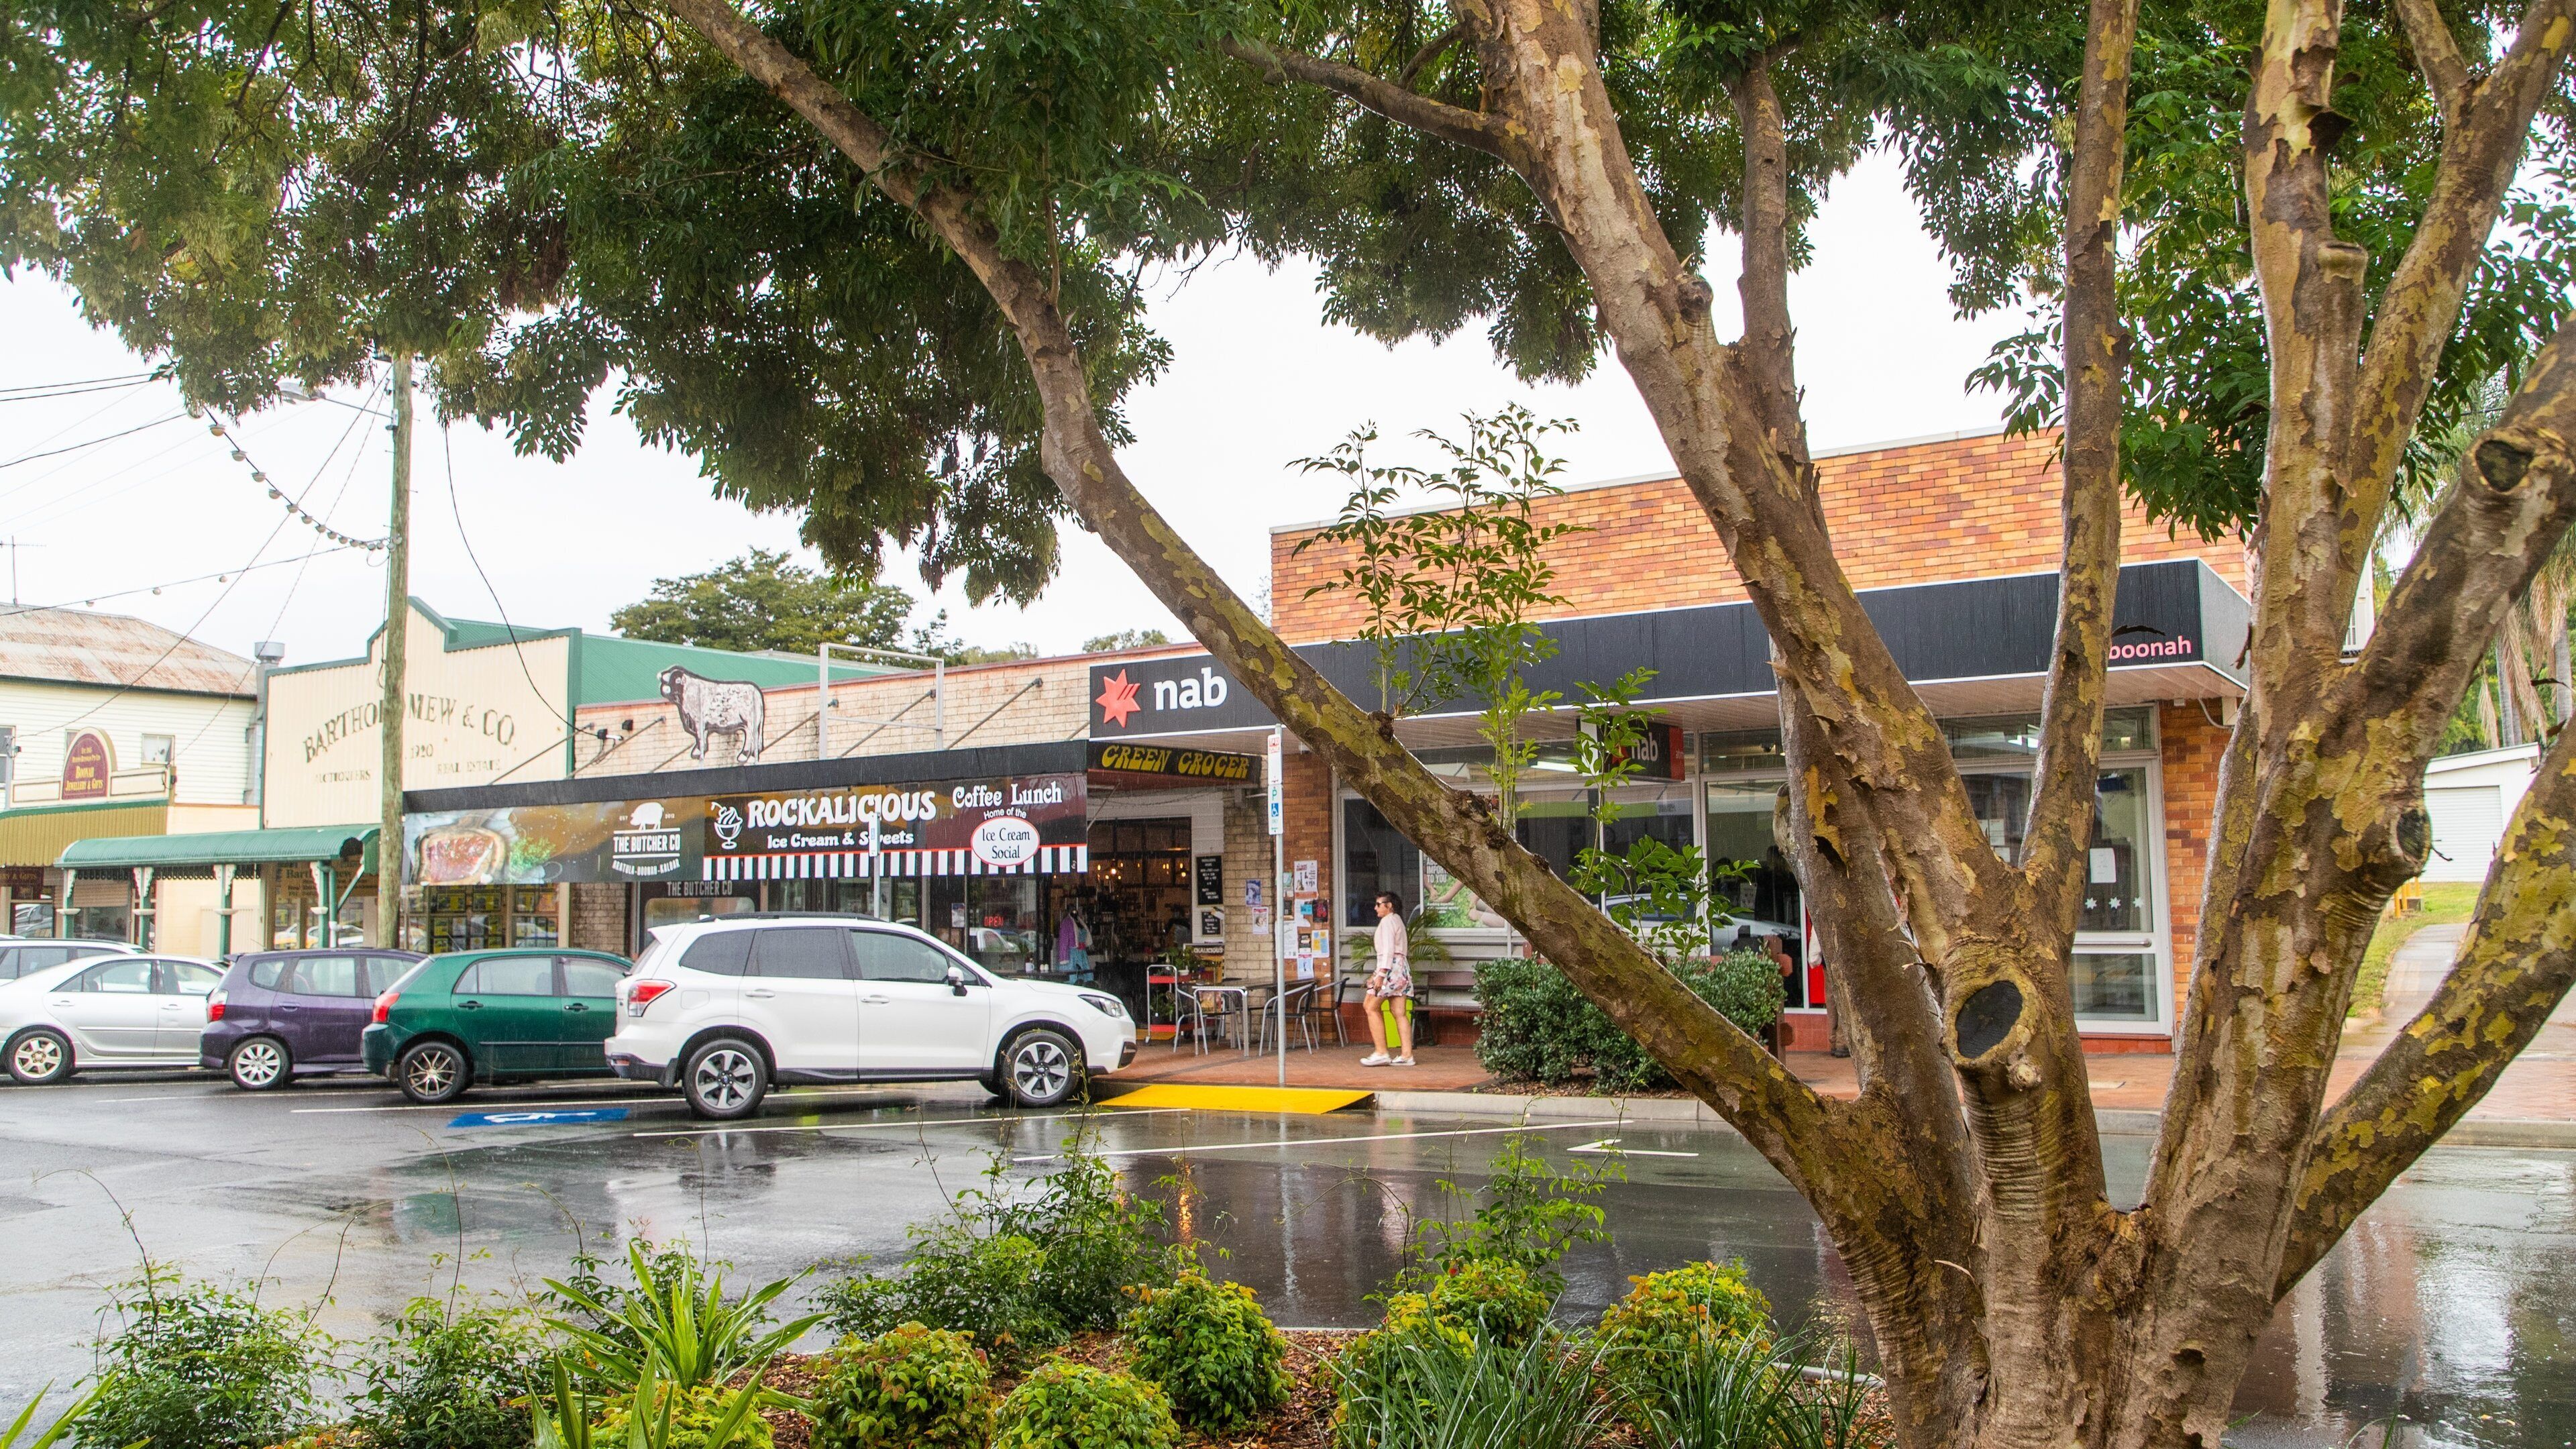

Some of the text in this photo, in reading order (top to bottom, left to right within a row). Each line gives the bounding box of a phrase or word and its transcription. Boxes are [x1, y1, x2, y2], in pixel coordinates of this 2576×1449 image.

[1154, 666, 1228, 711] nab
[303, 692, 457, 763] BARTHOMEW
[463, 704, 474, 729] &
[1631, 732, 1658, 762] nab
[1102, 745, 1250, 779] GREEN GROCER
[952, 780, 1063, 809] Coffee Lunch
[1272, 790, 1278, 801] P
[747, 791, 937, 829] ROCKALICIOUS
[983, 807, 1027, 820] Home of the
[613, 834, 681, 853] THE BUTCHER CO
[767, 830, 914, 850] Ice Cream & Seets
[982, 827, 1030, 841] Ice Cream
[991, 845, 1020, 859] Social
[667, 880, 733, 896] THE BUTCHER CO
[1427, 874, 1447, 883] TO YOU
[984, 916, 1004, 927] OPEN
